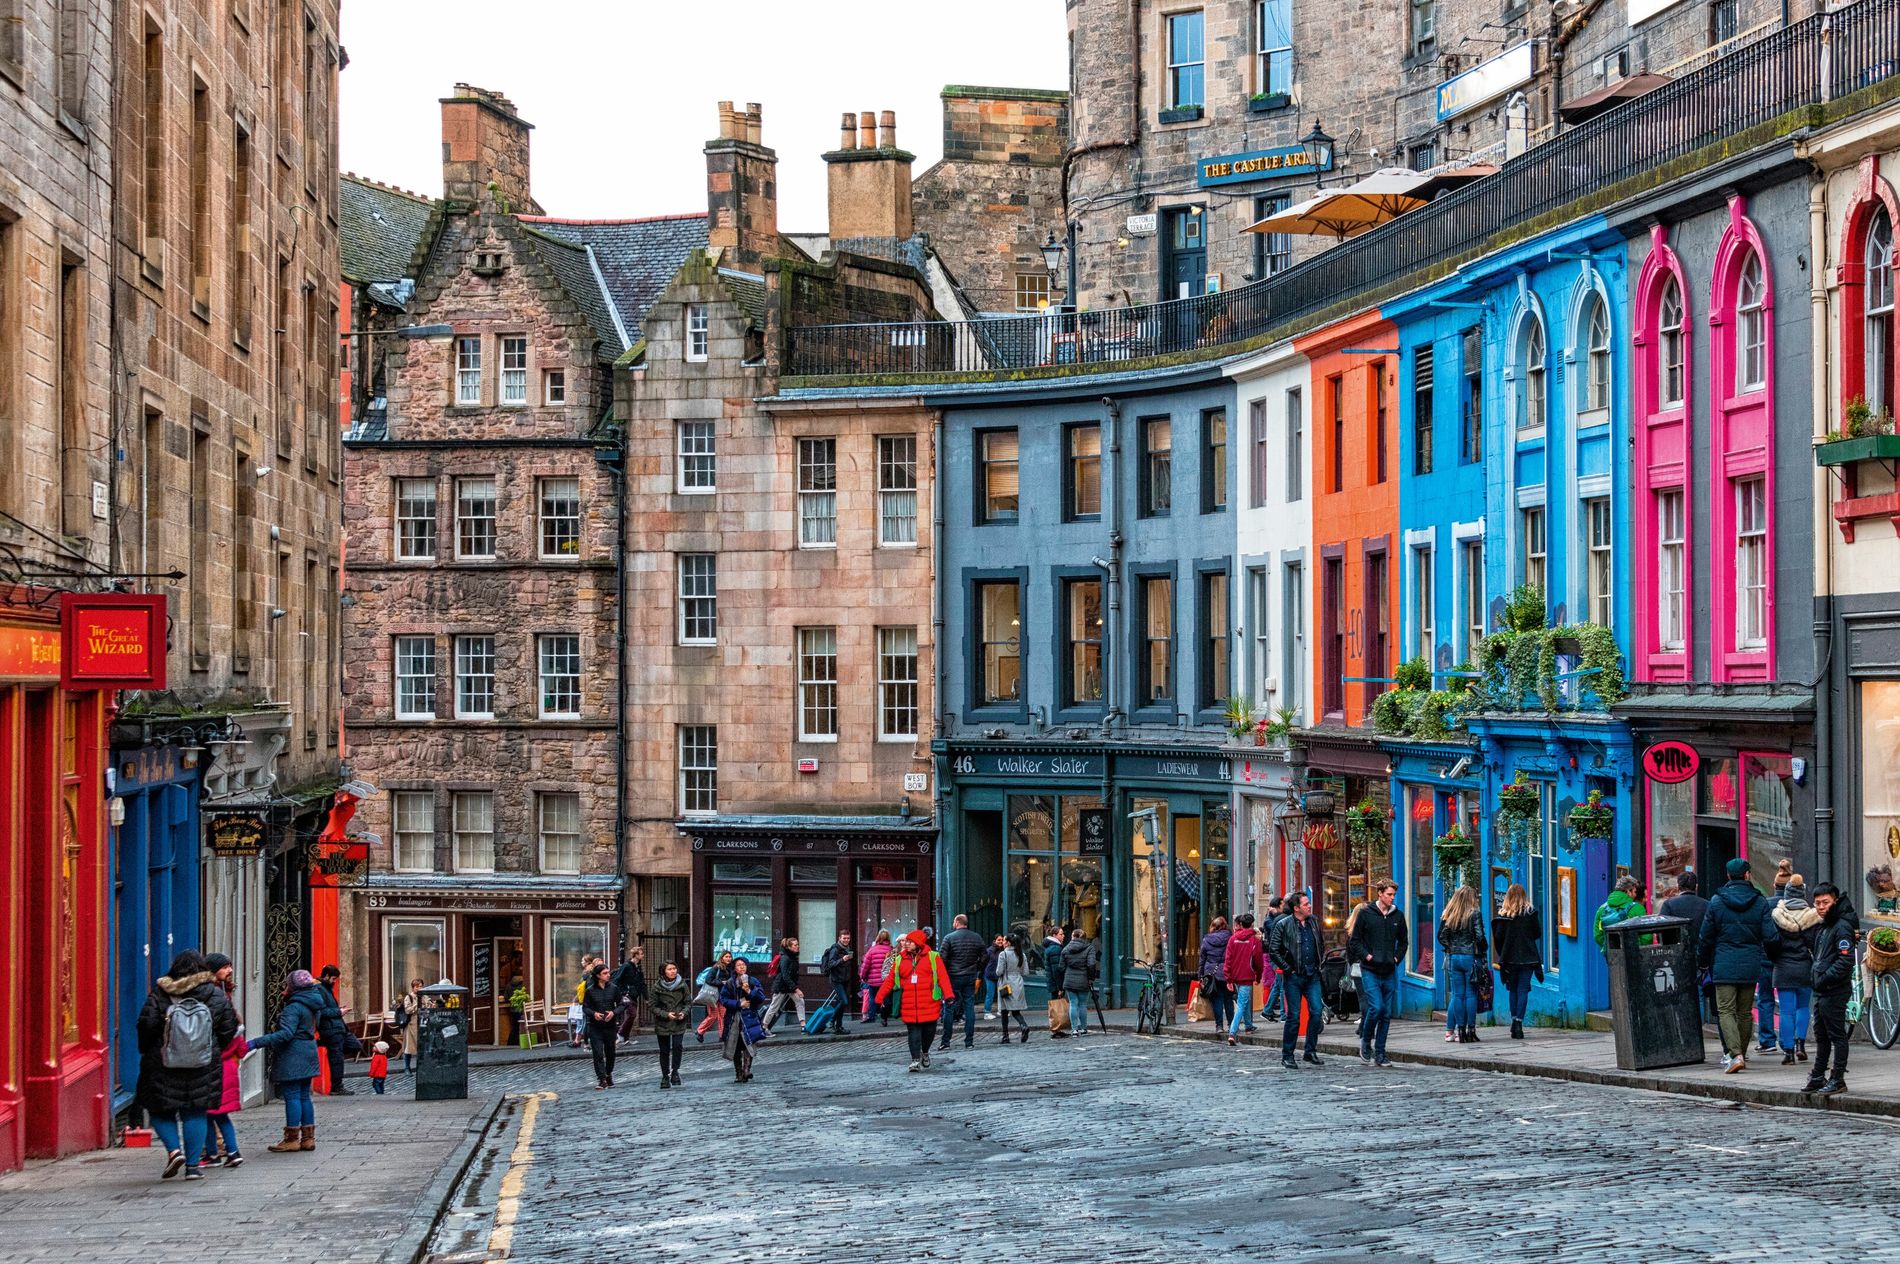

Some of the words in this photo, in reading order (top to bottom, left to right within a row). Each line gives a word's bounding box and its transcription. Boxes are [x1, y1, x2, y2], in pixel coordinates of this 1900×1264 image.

[1203, 163, 1230, 177] THE
[1233, 156, 1281, 173] CASTLE
[88, 625, 108, 637] THE
[108, 630, 140, 642] GREAT
[88, 638, 143, 655] WIZARD
[997, 756, 1043, 774] Walker
[1051, 757, 1089, 774] Slater
[1157, 762, 1199, 776] LADIESWEAR
[717, 841, 758, 849] CLARKSONS
[862, 843, 905, 851] CLARKSONS
[369, 896, 387, 907] 89
[398, 897, 433, 907] boulangerie
[598, 899, 617, 911] 89
